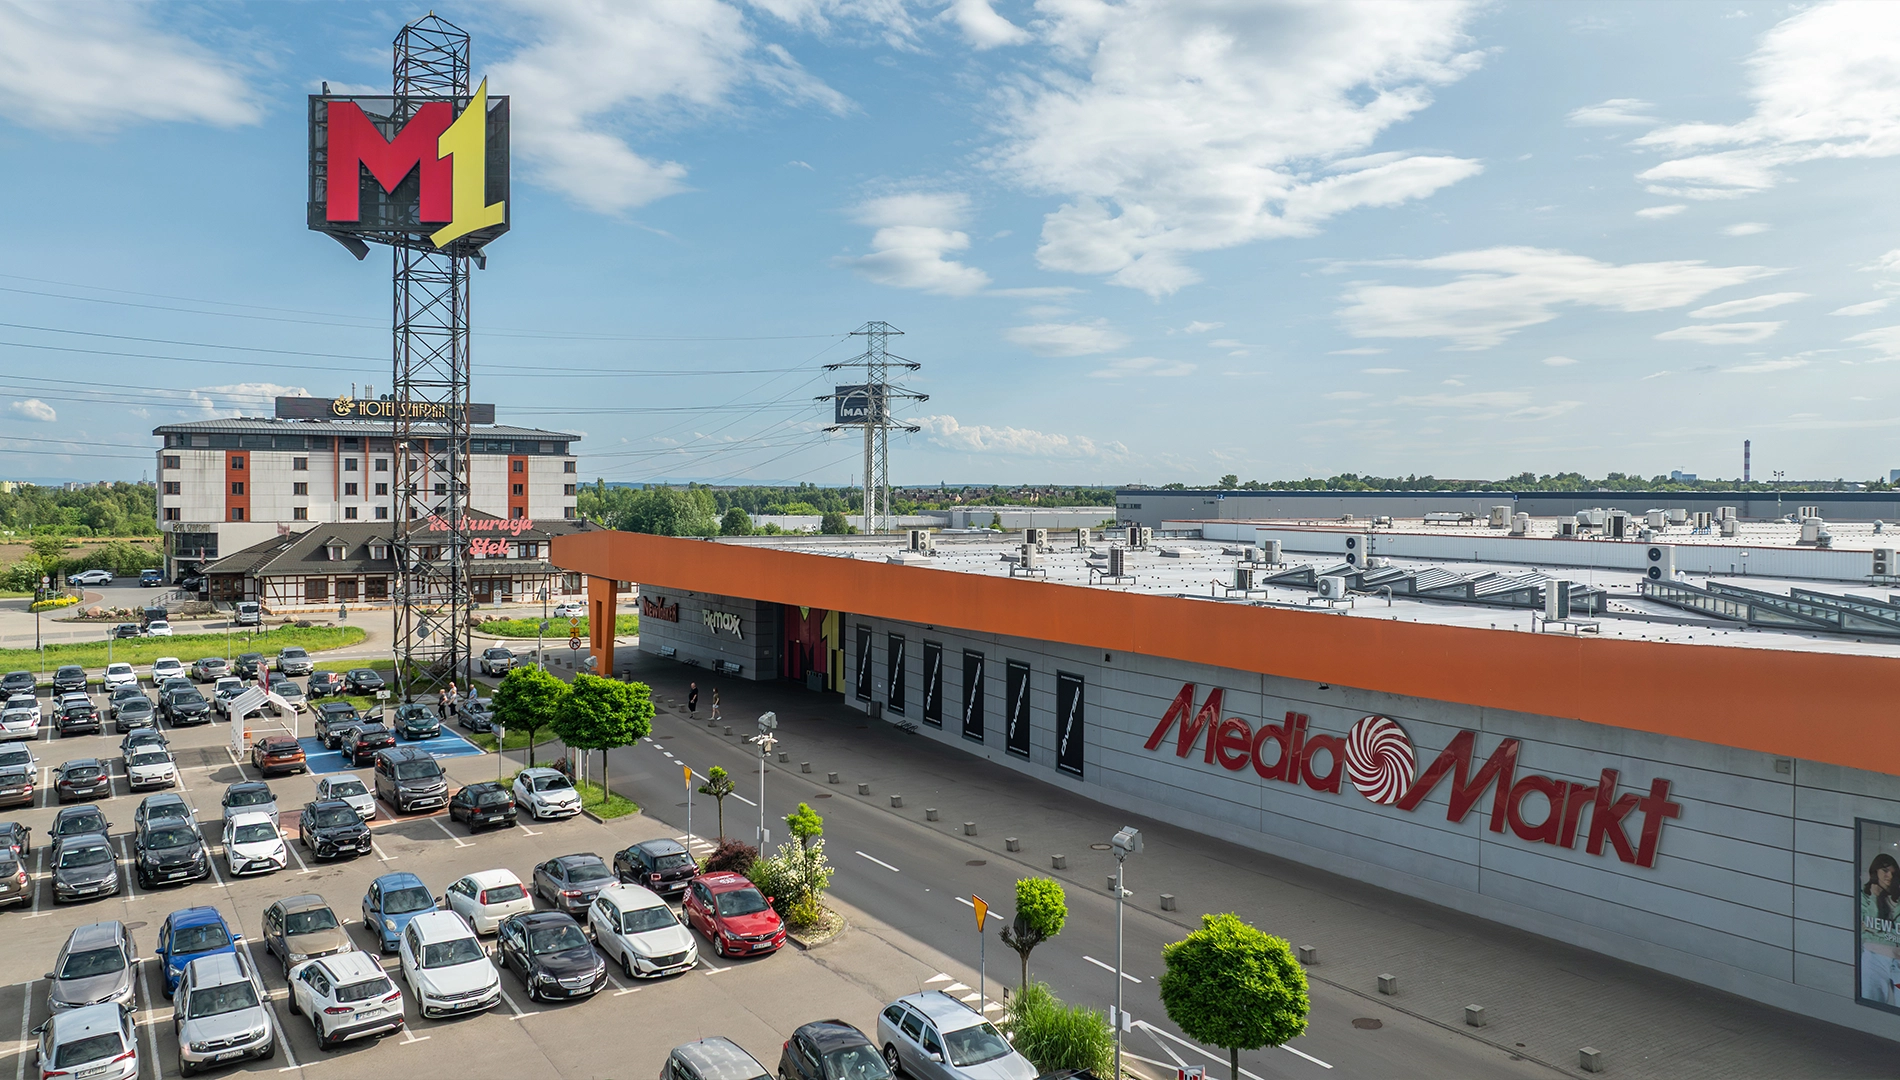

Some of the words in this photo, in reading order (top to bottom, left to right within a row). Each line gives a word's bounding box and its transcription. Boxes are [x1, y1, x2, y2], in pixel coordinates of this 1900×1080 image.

[326, 74, 505, 249] M1
[428, 514, 534, 536] Retauracja
[469, 537, 510, 555] Stek
[1143, 682, 1346, 795] Media
[1395, 729, 1683, 869] Markt
[1866, 915, 1892, 933] NEW
